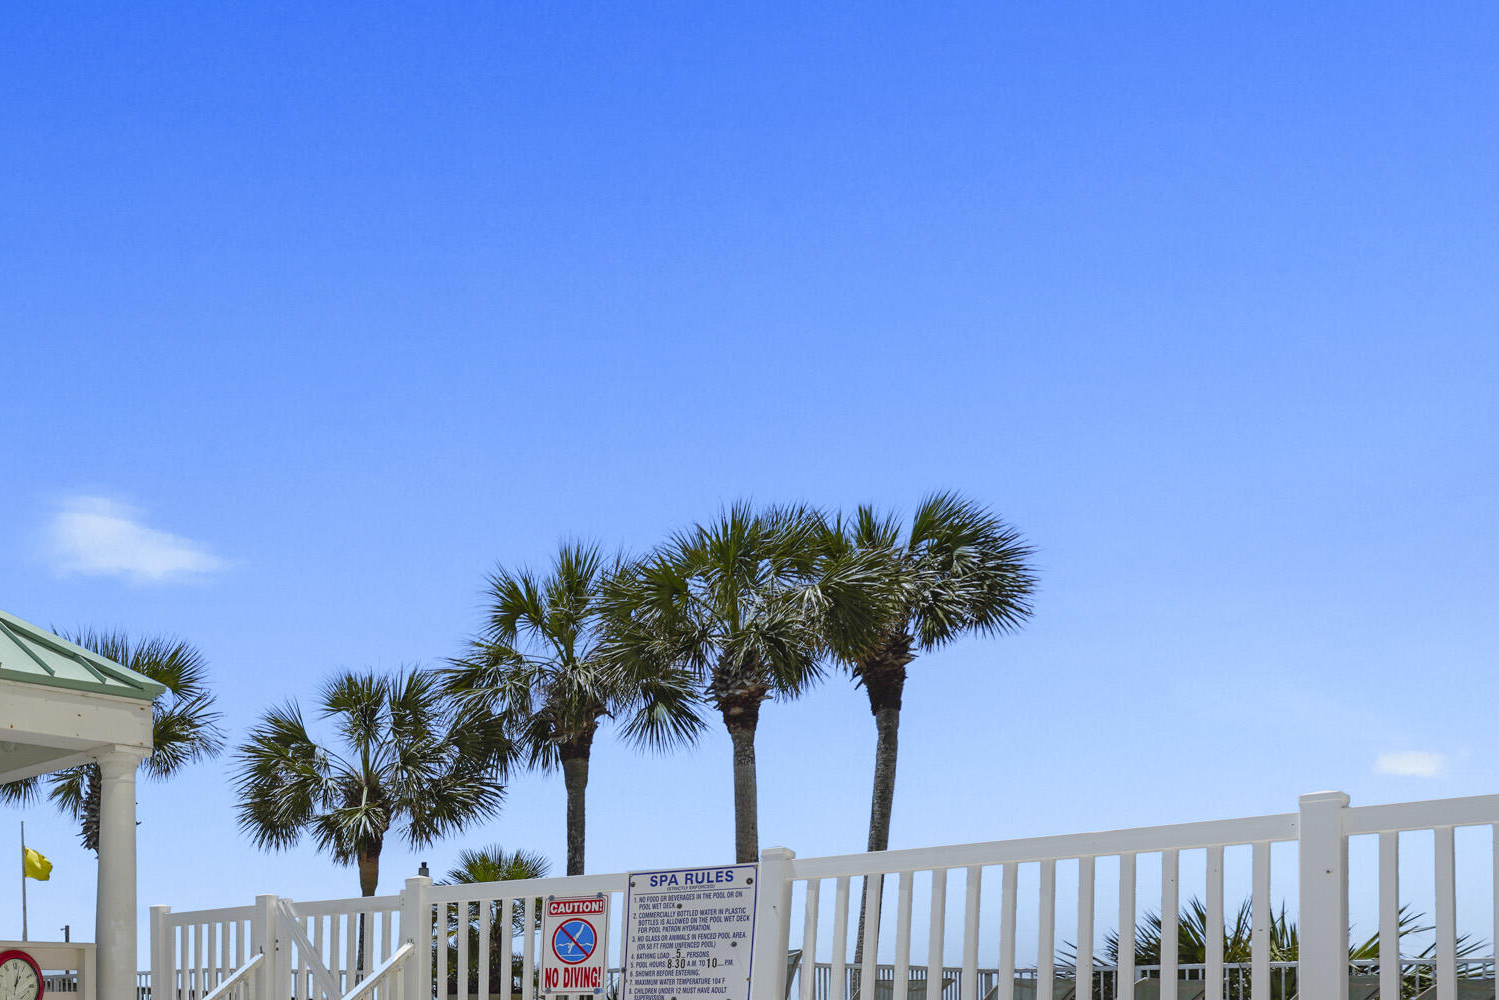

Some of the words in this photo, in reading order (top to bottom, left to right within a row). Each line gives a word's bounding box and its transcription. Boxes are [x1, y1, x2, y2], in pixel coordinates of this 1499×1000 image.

[650, 874, 678, 887] SPA
[685, 870, 733, 885] RULES
[550, 902, 603, 913] CAUTION!
[676, 949, 681, 958] 5
[707, 958, 717, 968] 10
[545, 968, 559, 988] NO
[563, 966, 601, 988] DIVING!
